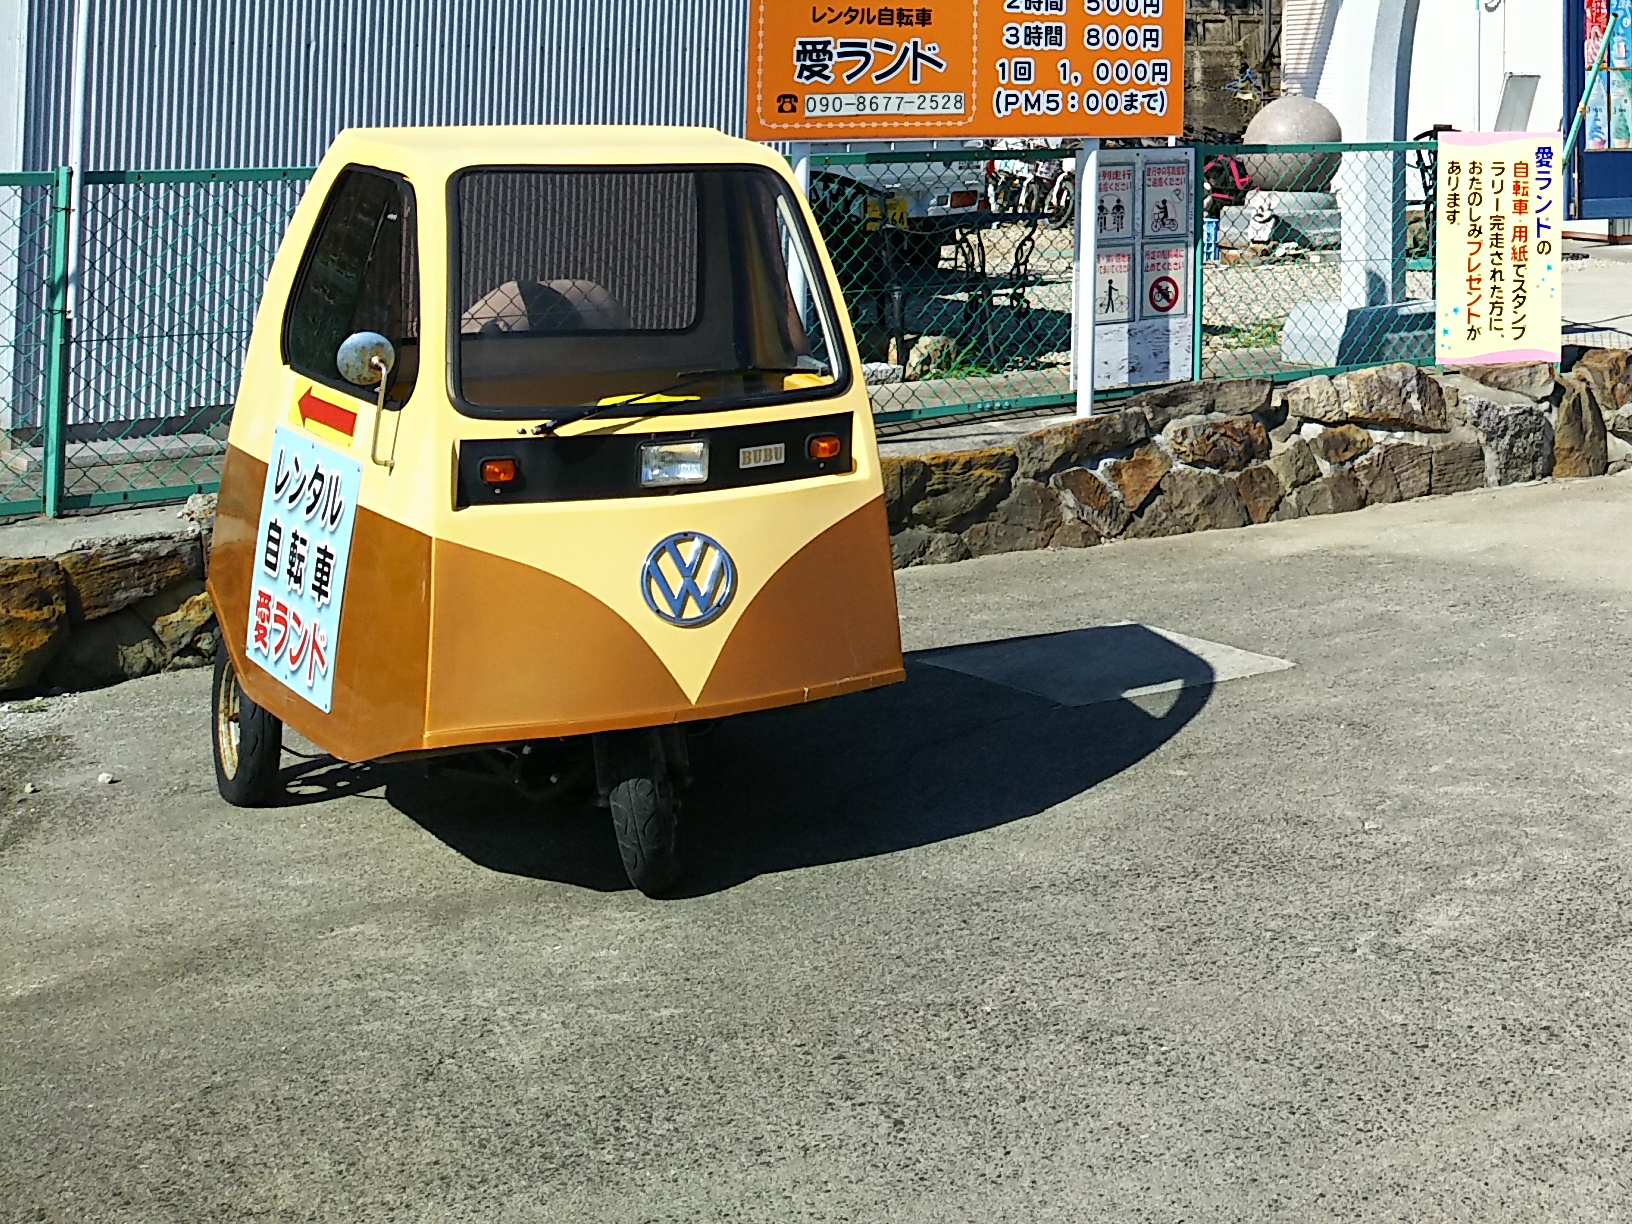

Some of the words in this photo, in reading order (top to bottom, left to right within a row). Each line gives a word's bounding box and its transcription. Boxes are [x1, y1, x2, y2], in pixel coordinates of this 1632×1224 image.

[812, 6, 932, 28] レンタル自転車
[1003, 26, 1064, 49] 3時間
[1085, 26, 1161, 50] 800円
[796, 40, 944, 83] 愛ランド
[998, 60, 1034, 83] 1回
[805, 93, 964, 114] 090-8677-2528
[993, 89, 1166, 115] (PM5:00まで)
[1098, 169, 1132, 182] 列走行
[1535, 146, 1553, 256] 愛ランドの
[1466, 161, 1483, 341] おたのしみプレゼントが
[742, 446, 783, 466] BUBU
[274, 449, 343, 528] レンタル
[264, 519, 335, 605] 自転車
[254, 590, 328, 682] 愛ランド
